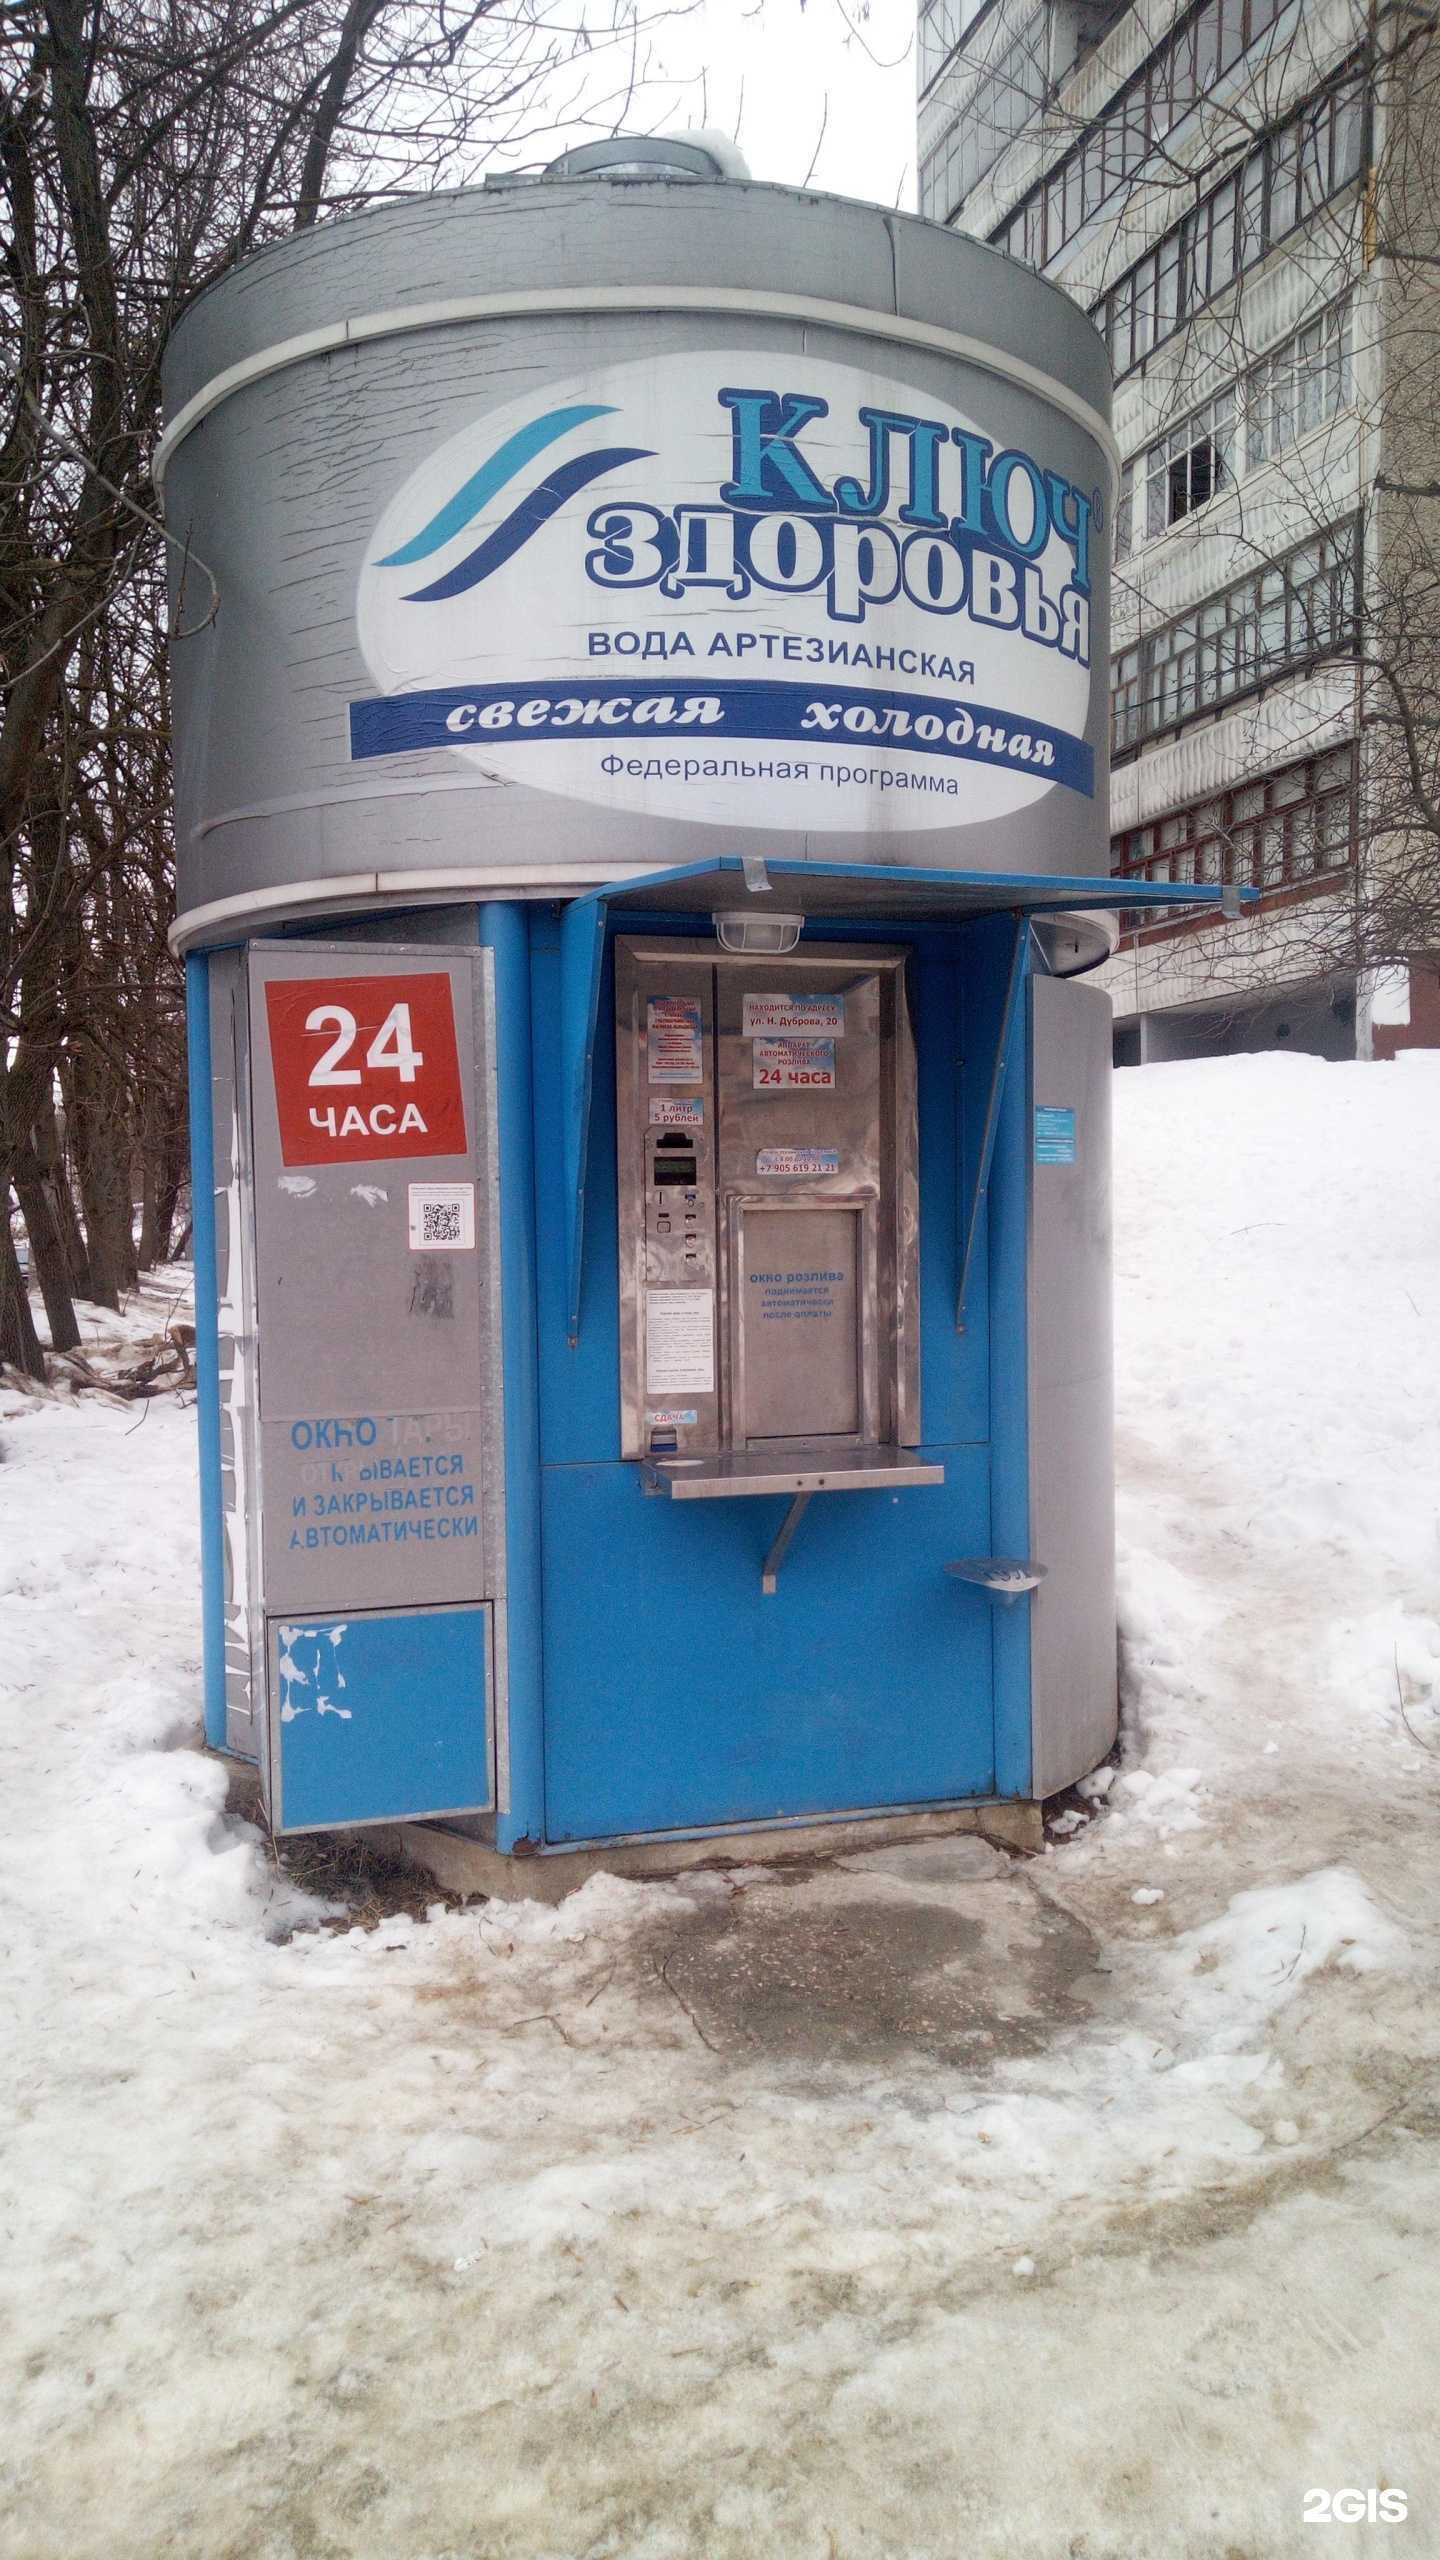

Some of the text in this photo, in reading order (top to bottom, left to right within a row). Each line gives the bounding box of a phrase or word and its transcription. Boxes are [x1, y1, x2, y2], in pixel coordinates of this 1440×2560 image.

[588, 631, 976, 685] ВОДА АРТЕЗИАНСКАЯ
[446, 693, 1055, 768] свежая холодная
[600, 754, 960, 798] Федеральная программа
[750, 1018, 764, 1027] ул.
[780, 1017, 823, 1027] Дуброва,
[825, 1017, 838, 1025] 20
[303, 1002, 424, 1087] 24
[759, 1068, 832, 1085] 24 часа
[309, 1103, 428, 1137] ЧАСА
[655, 1111, 699, 1122] 5 рублей
[670, 1105, 693, 1113] литр
[775, 1164, 791, 1172] 905
[750, 1271, 844, 1284] окно розлива
[291, 1416, 377, 1450] ОКНО
[292, 1485, 475, 1517] И ЗАКРЫВАЕТСЯ
[288, 1516, 479, 1550] АВТОМАТИЧЕСКИ
